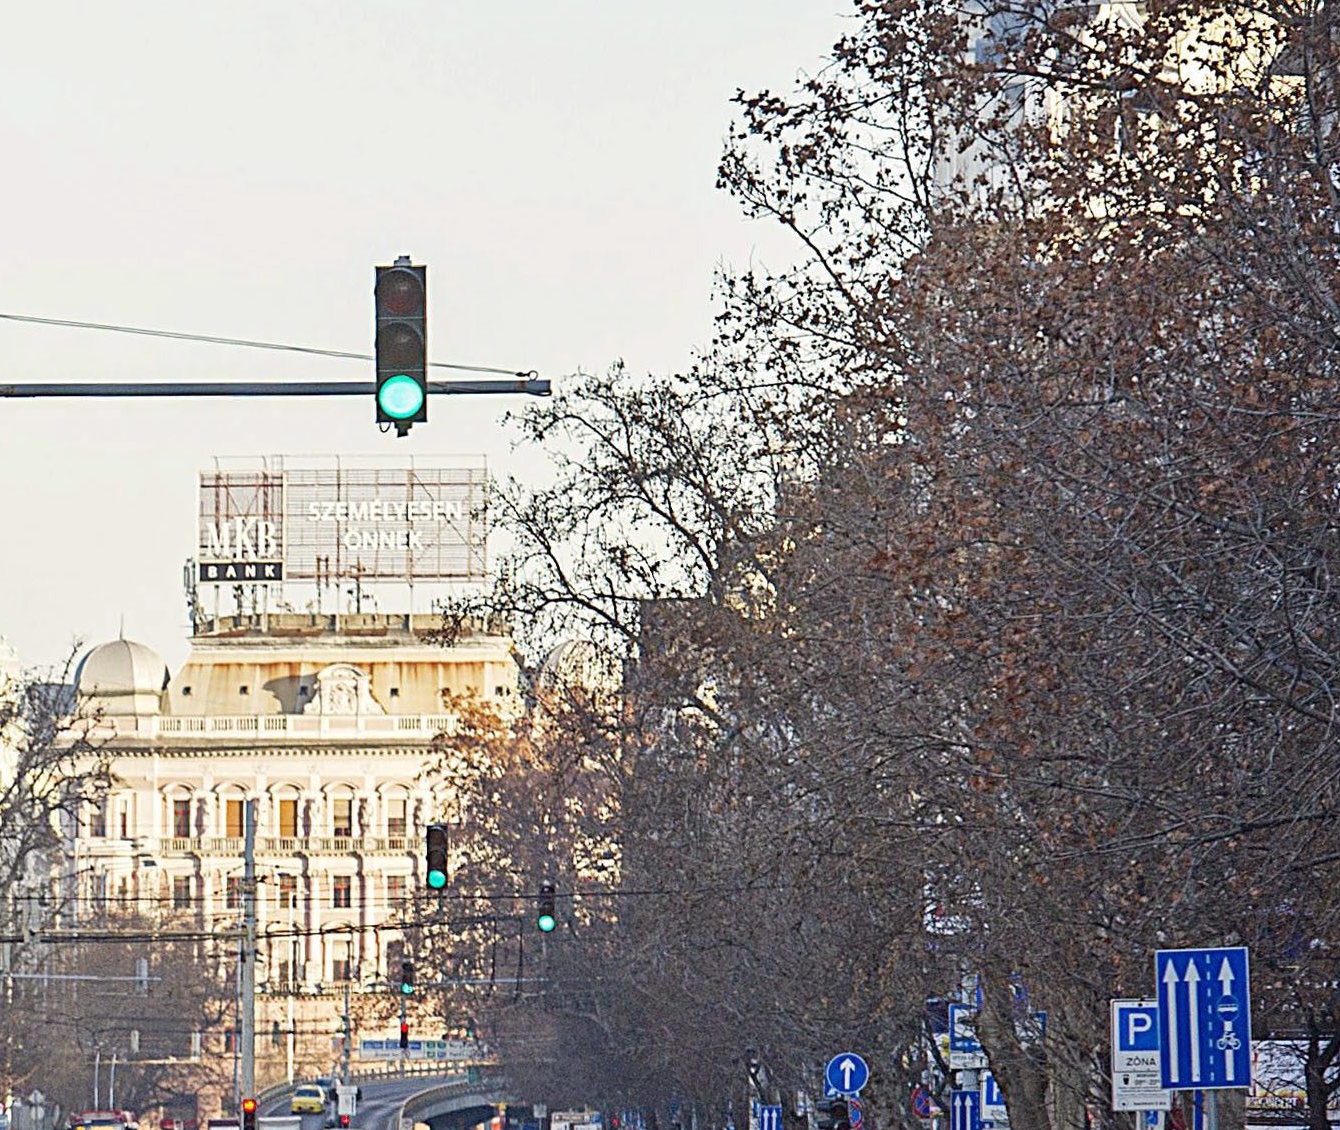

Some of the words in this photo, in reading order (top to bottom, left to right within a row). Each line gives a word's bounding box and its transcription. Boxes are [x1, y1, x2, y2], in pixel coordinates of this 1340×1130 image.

[307, 497, 463, 521] SZEMÉLYESEN
[205, 515, 278, 562] MKB
[343, 528, 425, 551] ÖNNEK
[207, 565, 276, 578] BANK
[1129, 1013, 1152, 1046] P
